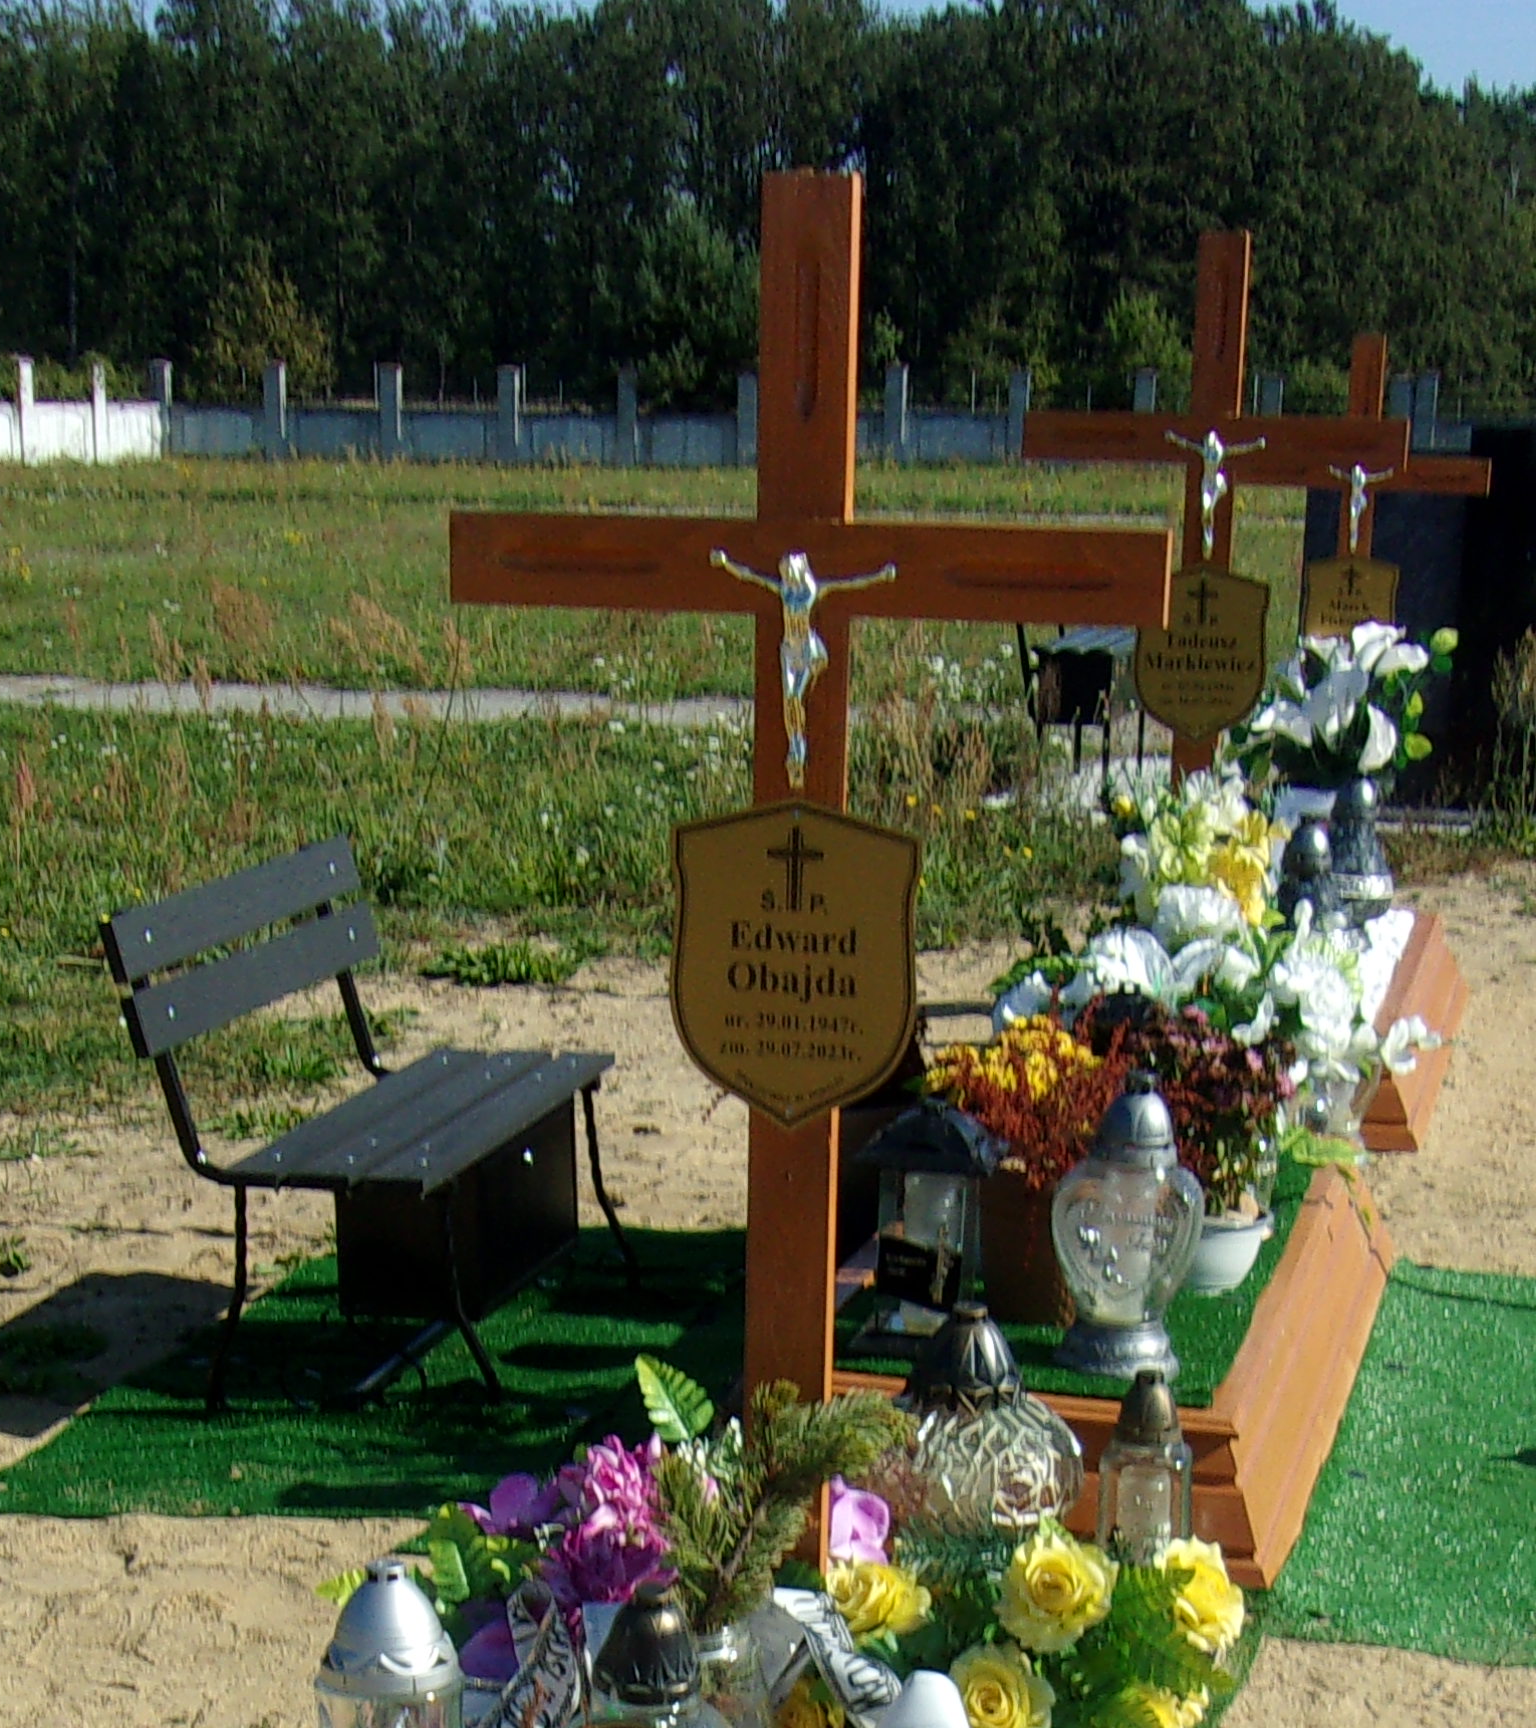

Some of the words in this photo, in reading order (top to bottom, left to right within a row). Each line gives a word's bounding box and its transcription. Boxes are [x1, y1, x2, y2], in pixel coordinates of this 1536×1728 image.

[1166, 632, 1237, 650] Tadeusz
[1146, 652, 1256, 673] Markiewicz
[730, 920, 858, 957] Edward
[727, 960, 857, 1004] Obajda
